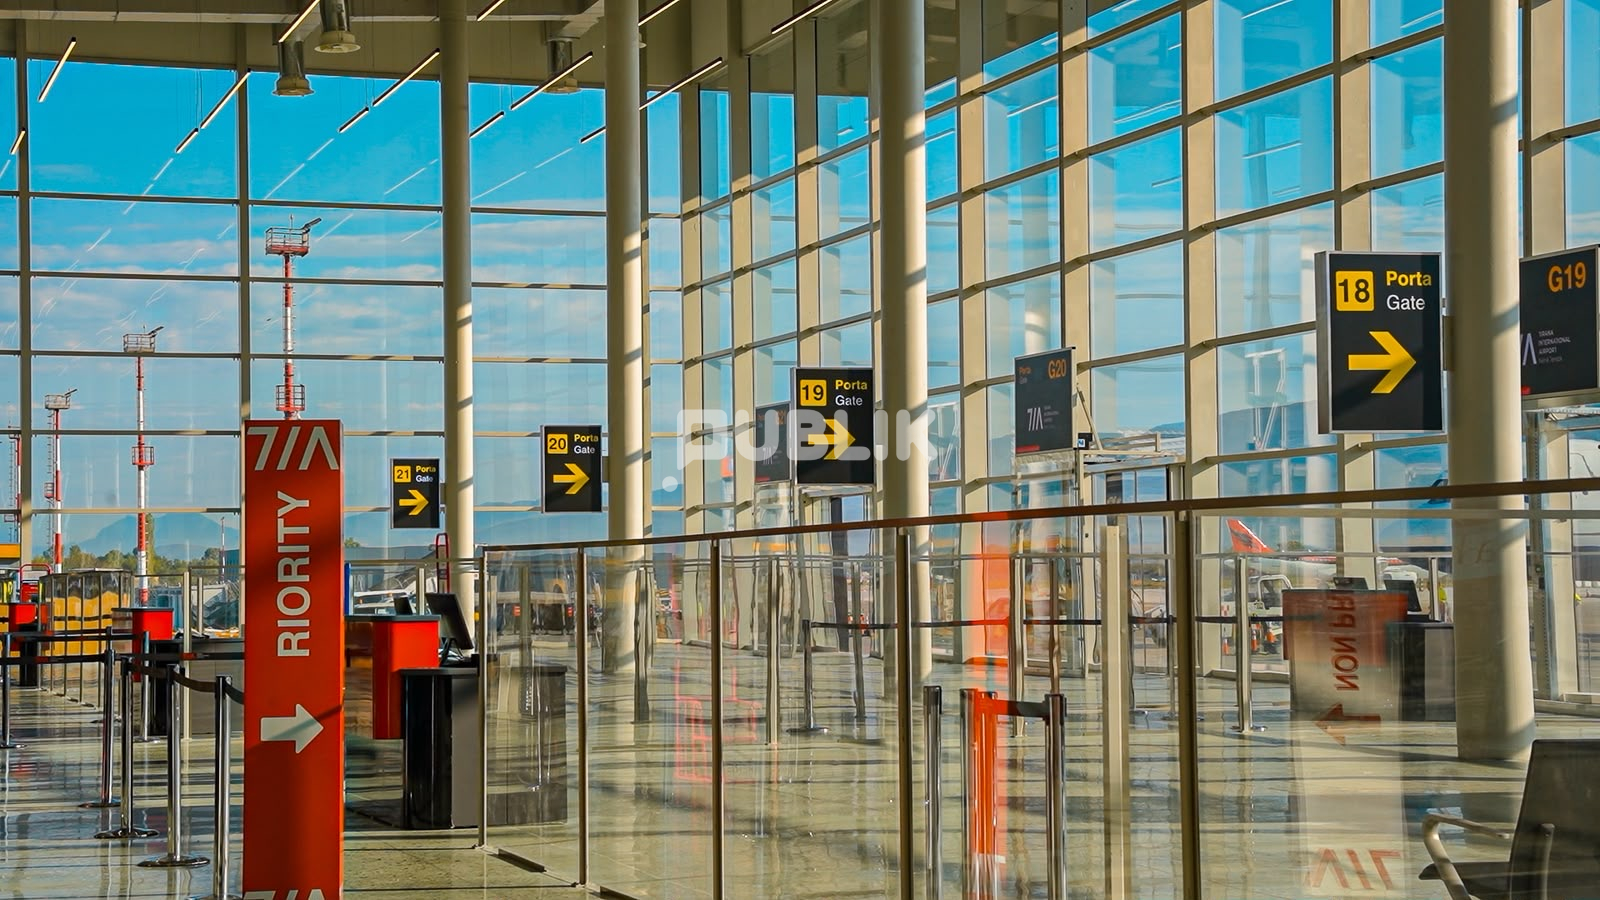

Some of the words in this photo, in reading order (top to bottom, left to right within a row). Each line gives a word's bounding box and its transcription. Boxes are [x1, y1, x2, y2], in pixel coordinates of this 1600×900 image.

[1548, 262, 1586, 292] G19
[1338, 278, 1370, 303] 18
[1386, 270, 1432, 287] Porta
[1386, 294, 1426, 311] Gate
[1048, 359, 1067, 379] G20
[802, 384, 824, 401] 19
[835, 379, 868, 391] Porta
[835, 395, 863, 406] Gate
[548, 437, 567, 451] 20
[573, 433, 599, 443] Porta
[573, 445, 596, 454] Gate
[396, 469, 409, 480] 21
[415, 465, 436, 473] Porta
[415, 474, 434, 483] Gate
[276, 490, 311, 657] RIORITY
